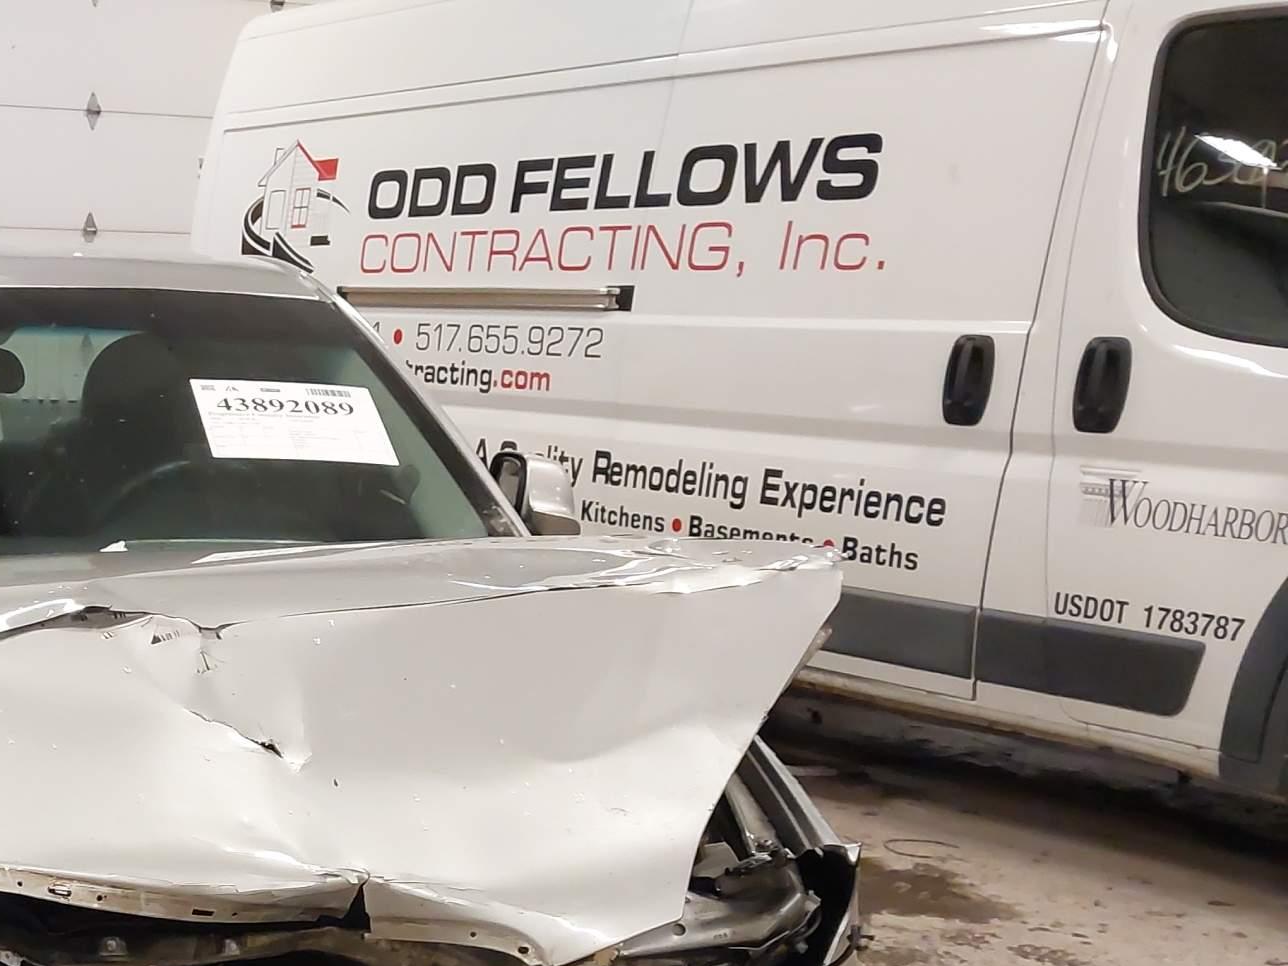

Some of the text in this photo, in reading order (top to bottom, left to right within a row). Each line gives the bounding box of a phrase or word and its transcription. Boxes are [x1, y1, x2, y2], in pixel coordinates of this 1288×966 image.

[367, 132, 884, 219] ODD FELLOWS
[360, 220, 886, 277] CONTRACTING, Inc.
[415, 323, 604, 359] 517.655.9272
[405, 360, 551, 394] racting.com
[216, 397, 354, 416] 43892089
[592, 450, 749, 510] Remodeling
[760, 468, 946, 527] Experience
[581, 500, 664, 533] Kitchens
[842, 537, 919, 571] Baths
[1054, 592, 1245, 642] USDOT 1783787
